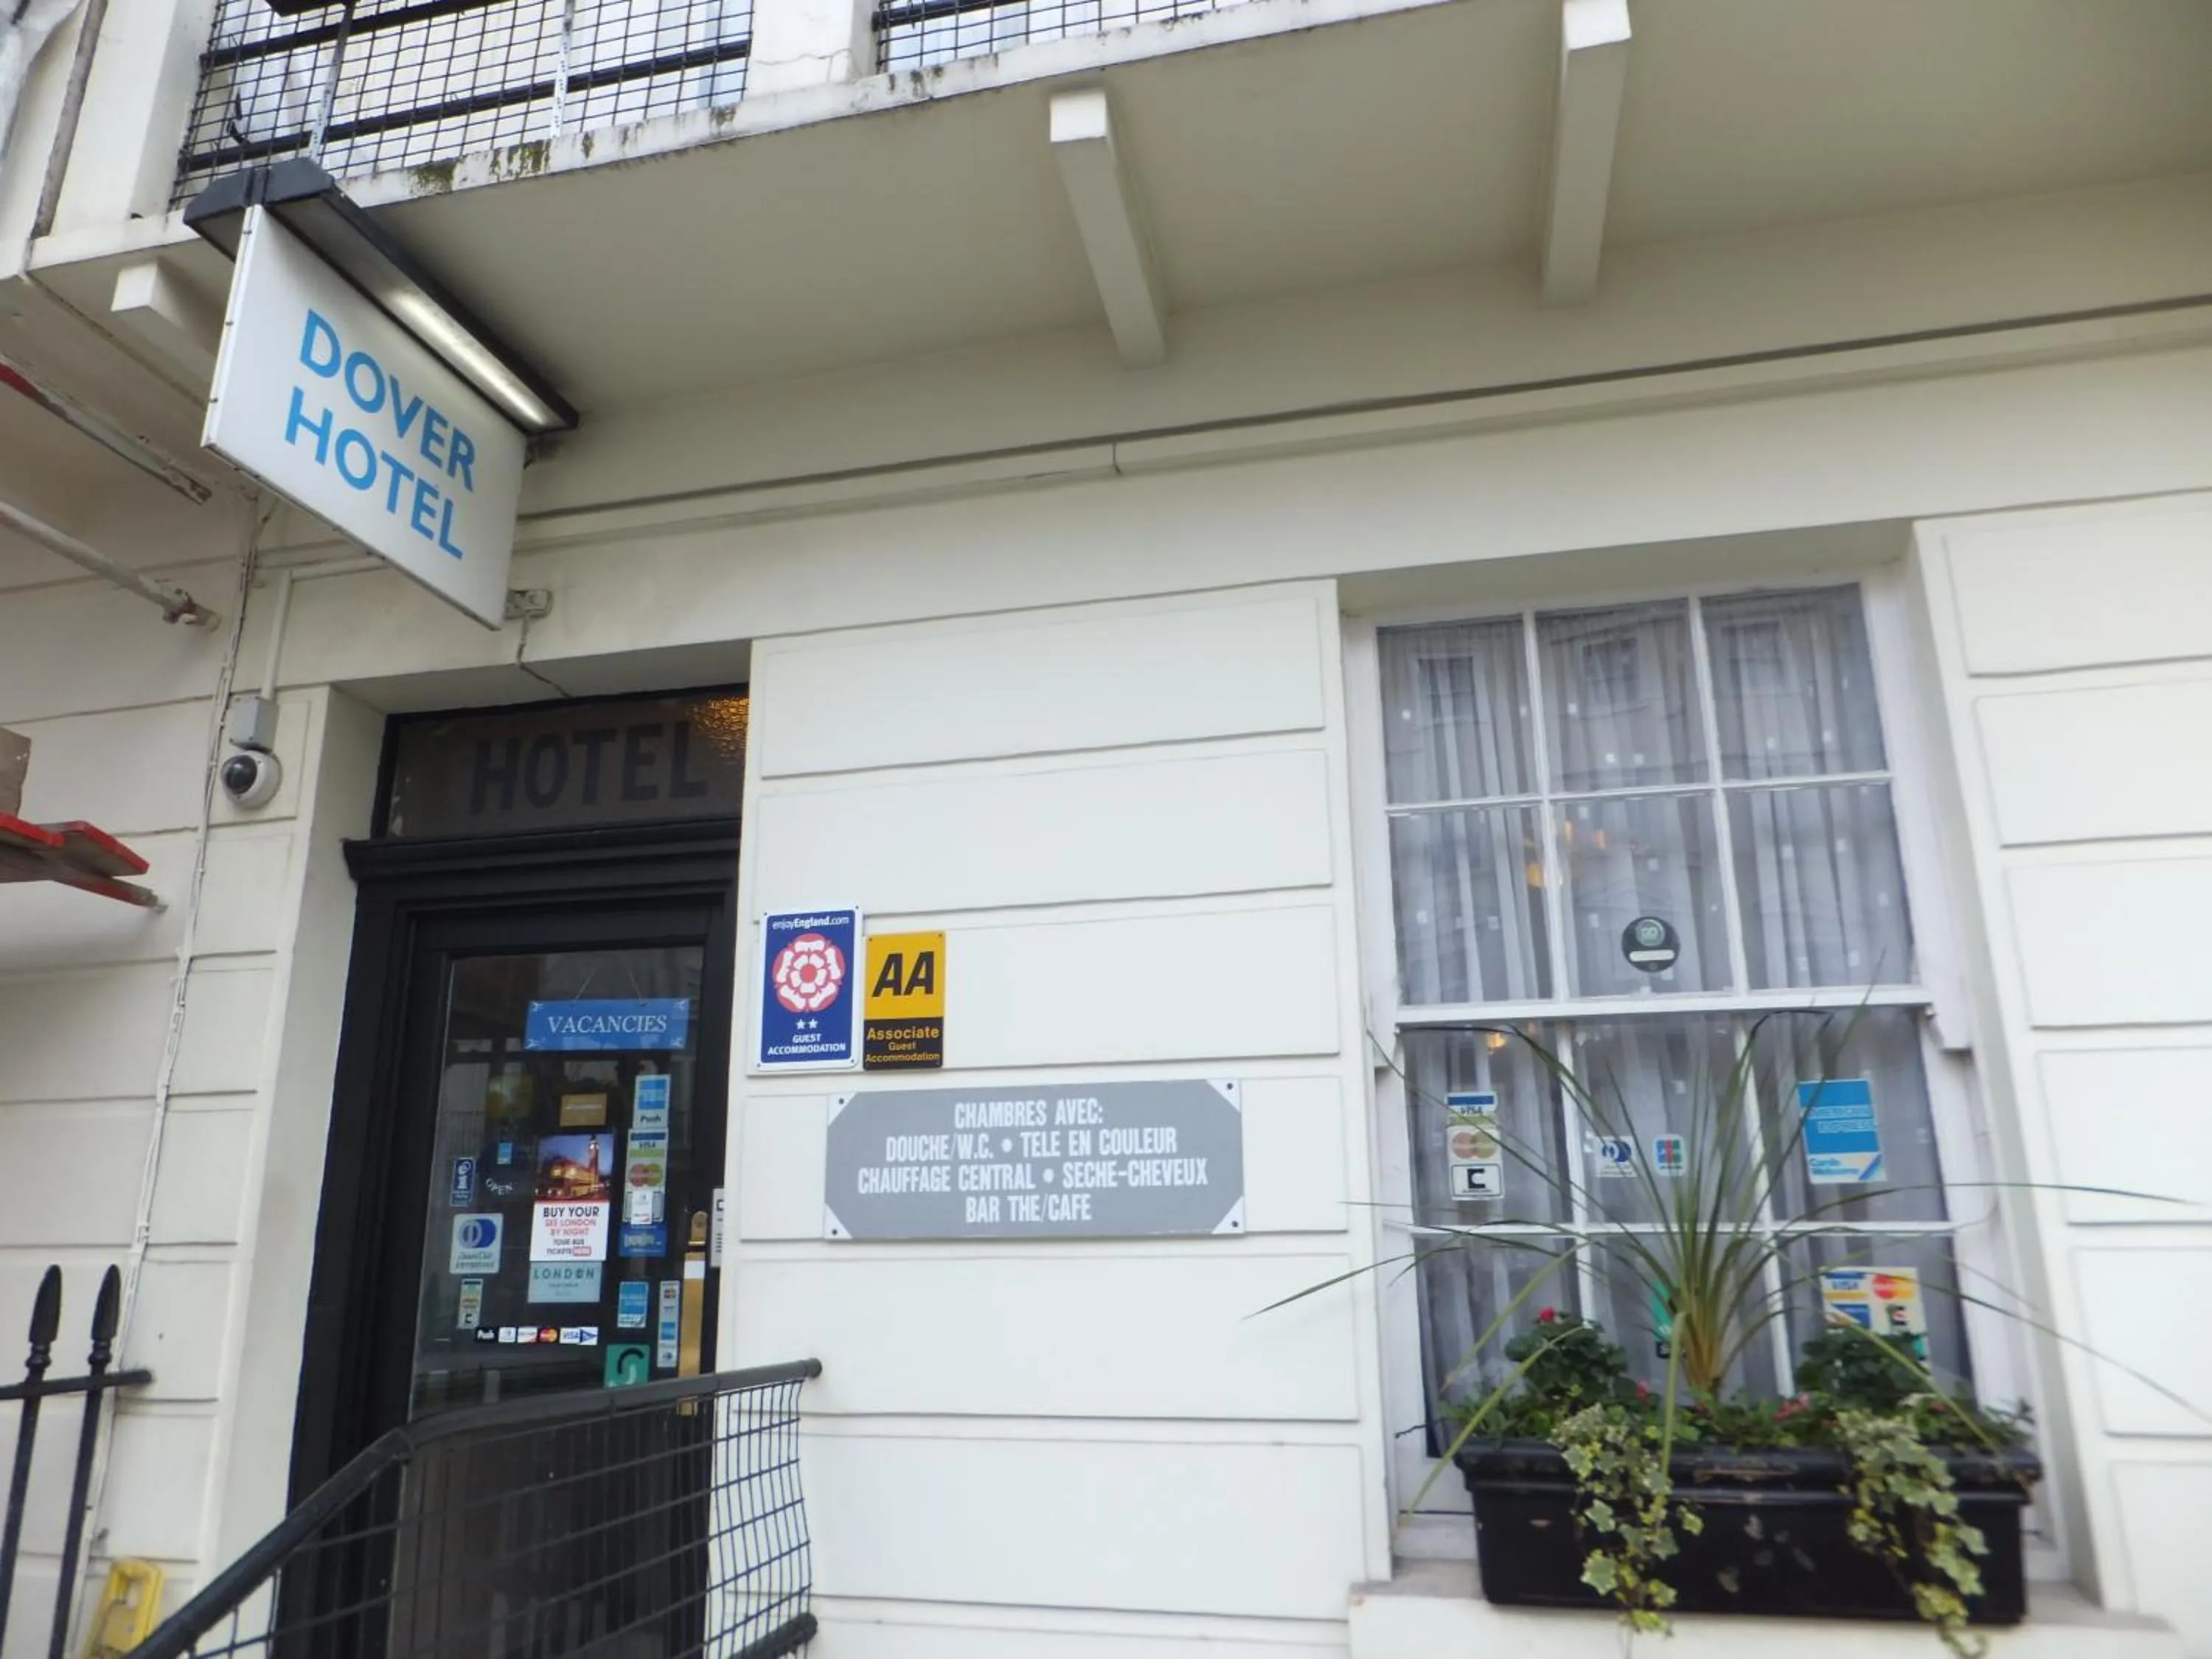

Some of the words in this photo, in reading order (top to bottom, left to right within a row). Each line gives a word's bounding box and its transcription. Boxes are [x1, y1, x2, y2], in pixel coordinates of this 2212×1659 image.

[299, 308, 476, 493] DOVER
[285, 386, 463, 561] HOTEL
[470, 720, 708, 814] HOTEL
[772, 915, 850, 930] enjoyEngland.com
[872, 951, 935, 998] AA
[548, 1015, 667, 1034] VACANCIES
[866, 1026, 939, 1040] Associate
[792, 1034, 822, 1043] GUEST
[888, 1041, 917, 1051] Guest
[768, 1043, 846, 1055] ACCOMMODATION
[866, 1052, 940, 1063] Accommodation
[954, 1099, 1047, 1129] CHAMBRES
[1054, 1097, 1104, 1125] AVEC:
[1019, 1130, 1060, 1158] TELE
[1068, 1130, 1091, 1156] EN
[1099, 1127, 1177, 1155] COULEUR
[858, 1166, 951, 1194] CHAUFFAGE
[959, 1163, 1036, 1191] CENTRAL
[1062, 1158, 1208, 1189] SECHE-CHEVEUX
[543, 1207, 566, 1217] BUY
[568, 1206, 599, 1217] YOUR
[966, 1196, 1000, 1222] BAR
[534, 1268, 594, 1279] LONDON
